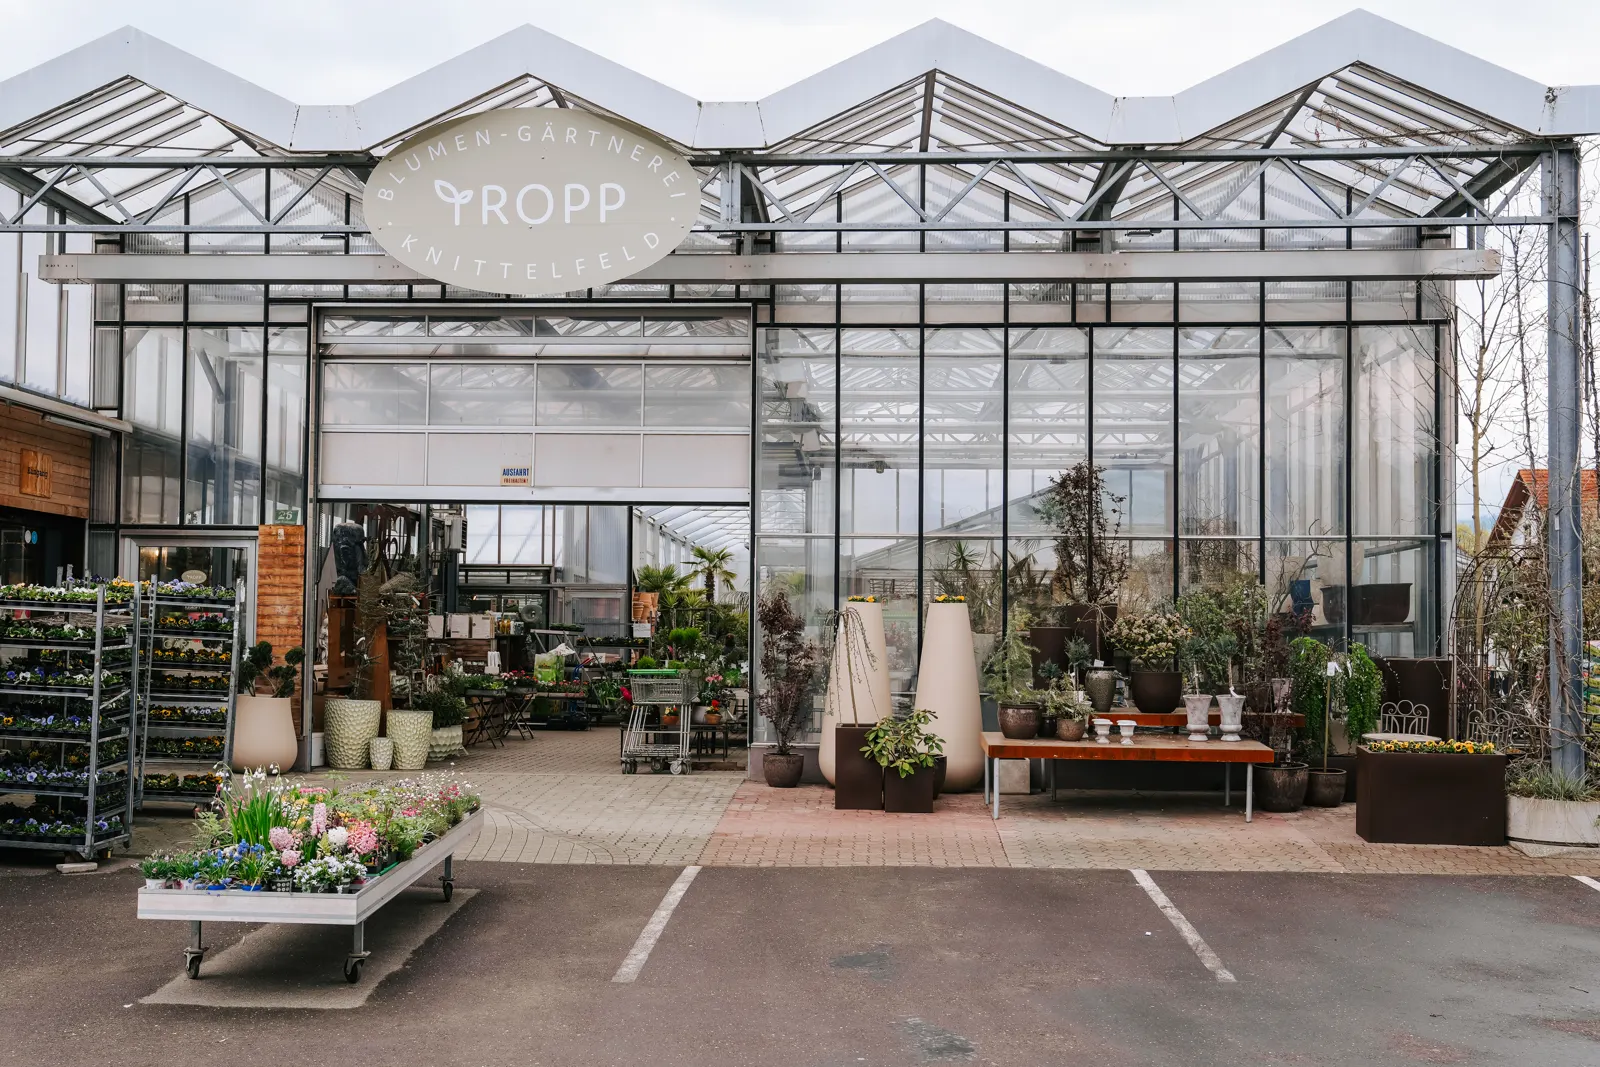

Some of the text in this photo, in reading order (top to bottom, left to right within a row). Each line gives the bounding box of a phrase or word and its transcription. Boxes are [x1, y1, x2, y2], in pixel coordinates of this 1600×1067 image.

[377, 121, 687, 202] BLUMEN-GÄRTNEREI
[401, 232, 660, 280] KNITTELFELD
[502, 468, 529, 477] AUSFAHRT
[278, 510, 293, 520] 26
